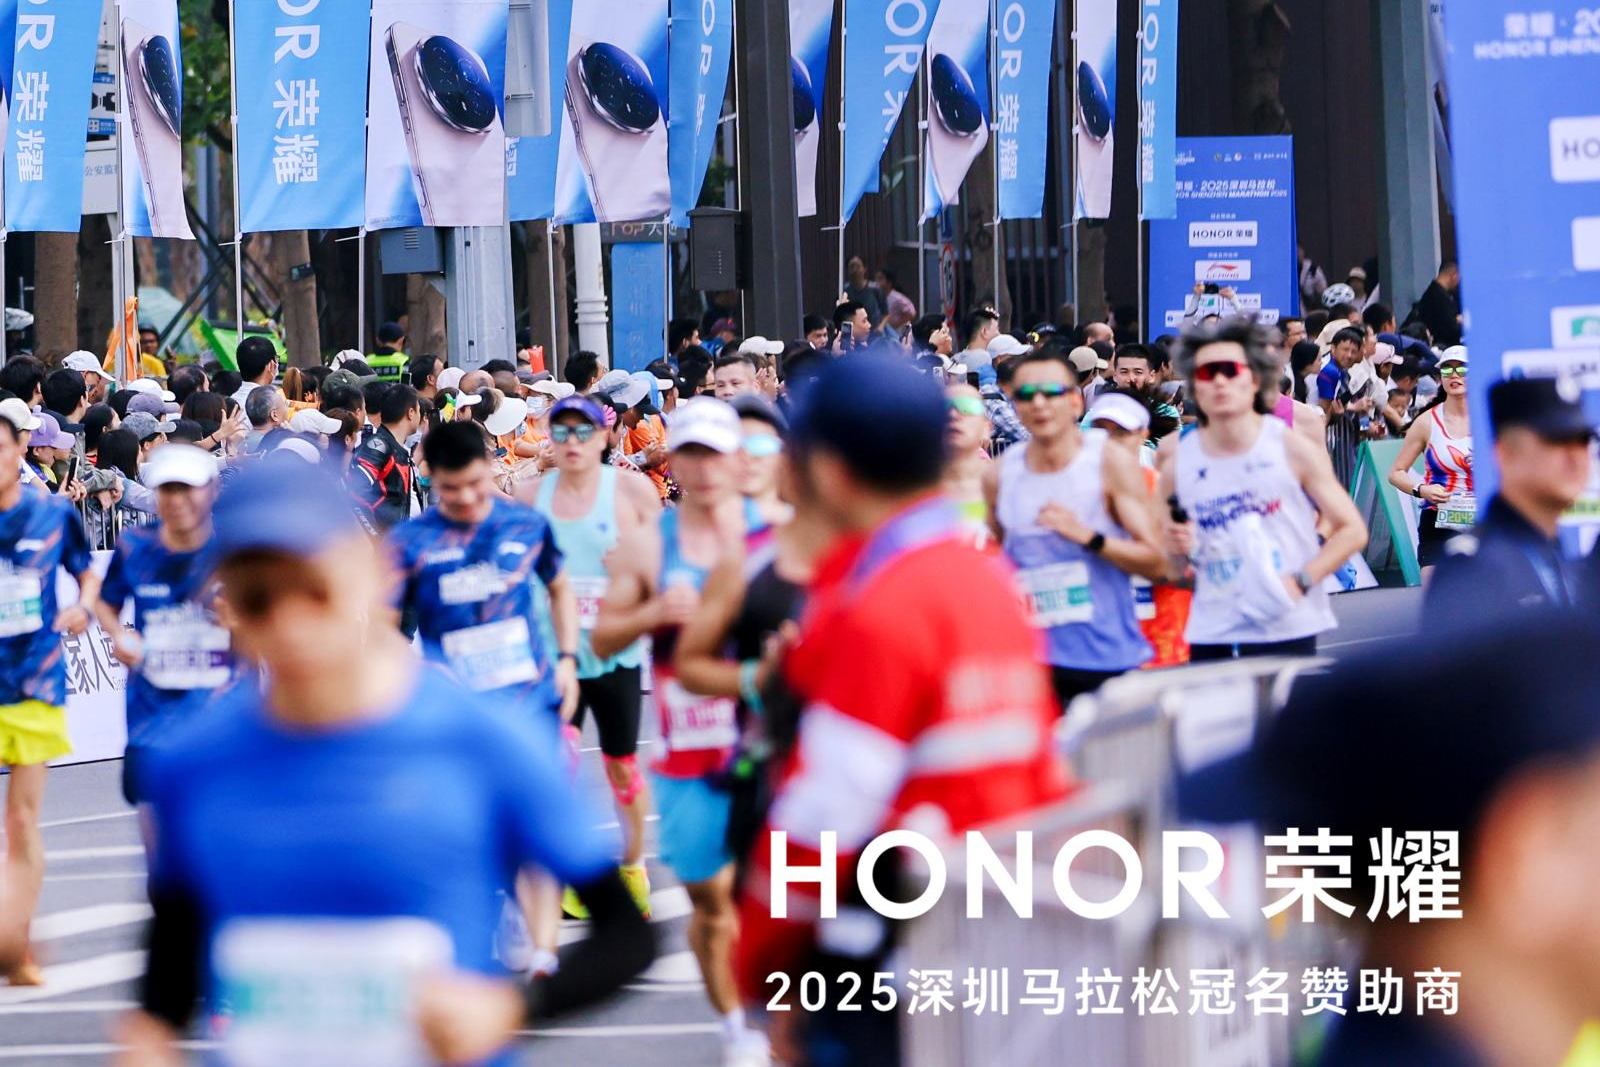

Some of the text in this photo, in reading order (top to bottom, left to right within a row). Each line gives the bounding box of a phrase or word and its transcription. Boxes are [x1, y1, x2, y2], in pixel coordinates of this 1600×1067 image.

[16, 70, 49, 183] 荣耀
[273, 79, 319, 185] 荣耀
[999, 93, 1020, 181] 荣耀
[1193, 230, 1233, 239] HONOR
